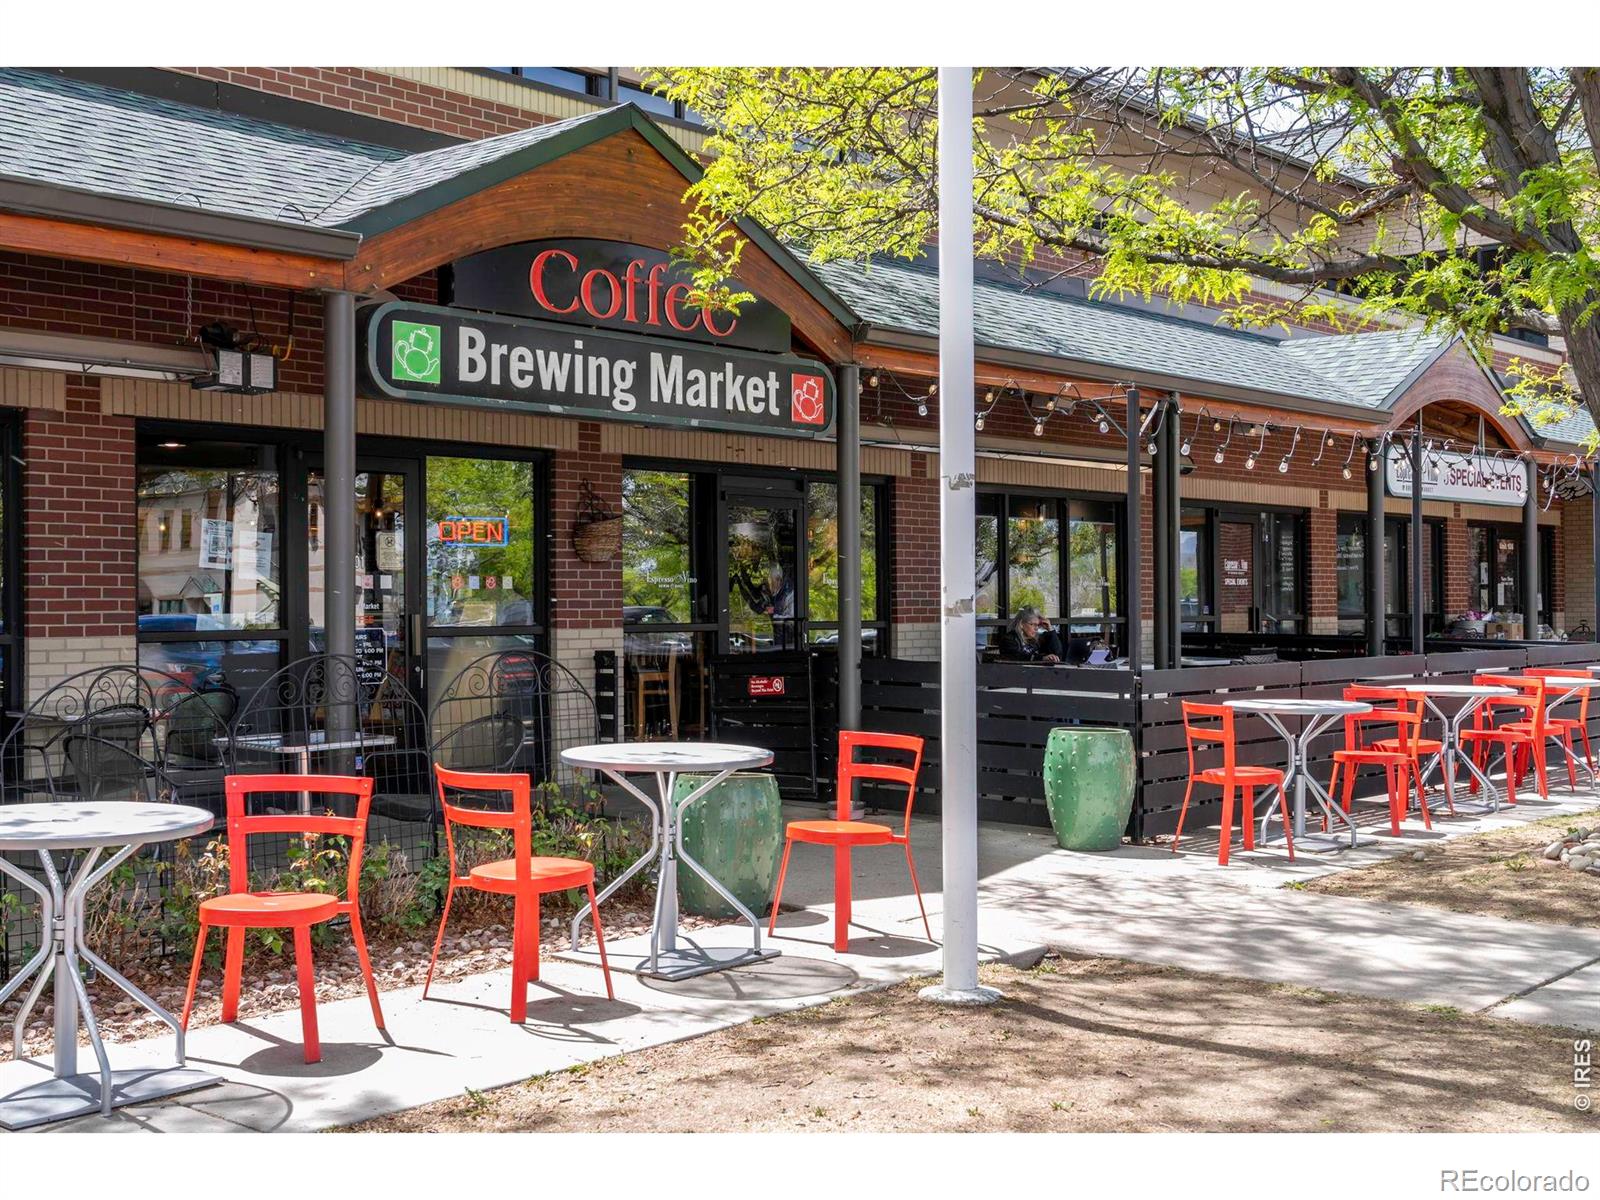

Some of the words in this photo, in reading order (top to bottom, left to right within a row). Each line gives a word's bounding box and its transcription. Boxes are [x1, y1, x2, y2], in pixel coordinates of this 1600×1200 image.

[529, 249, 737, 337] Coffee
[458, 325, 637, 412] Brewing
[650, 351, 780, 416] Market
[438, 521, 503, 542] OPEN
